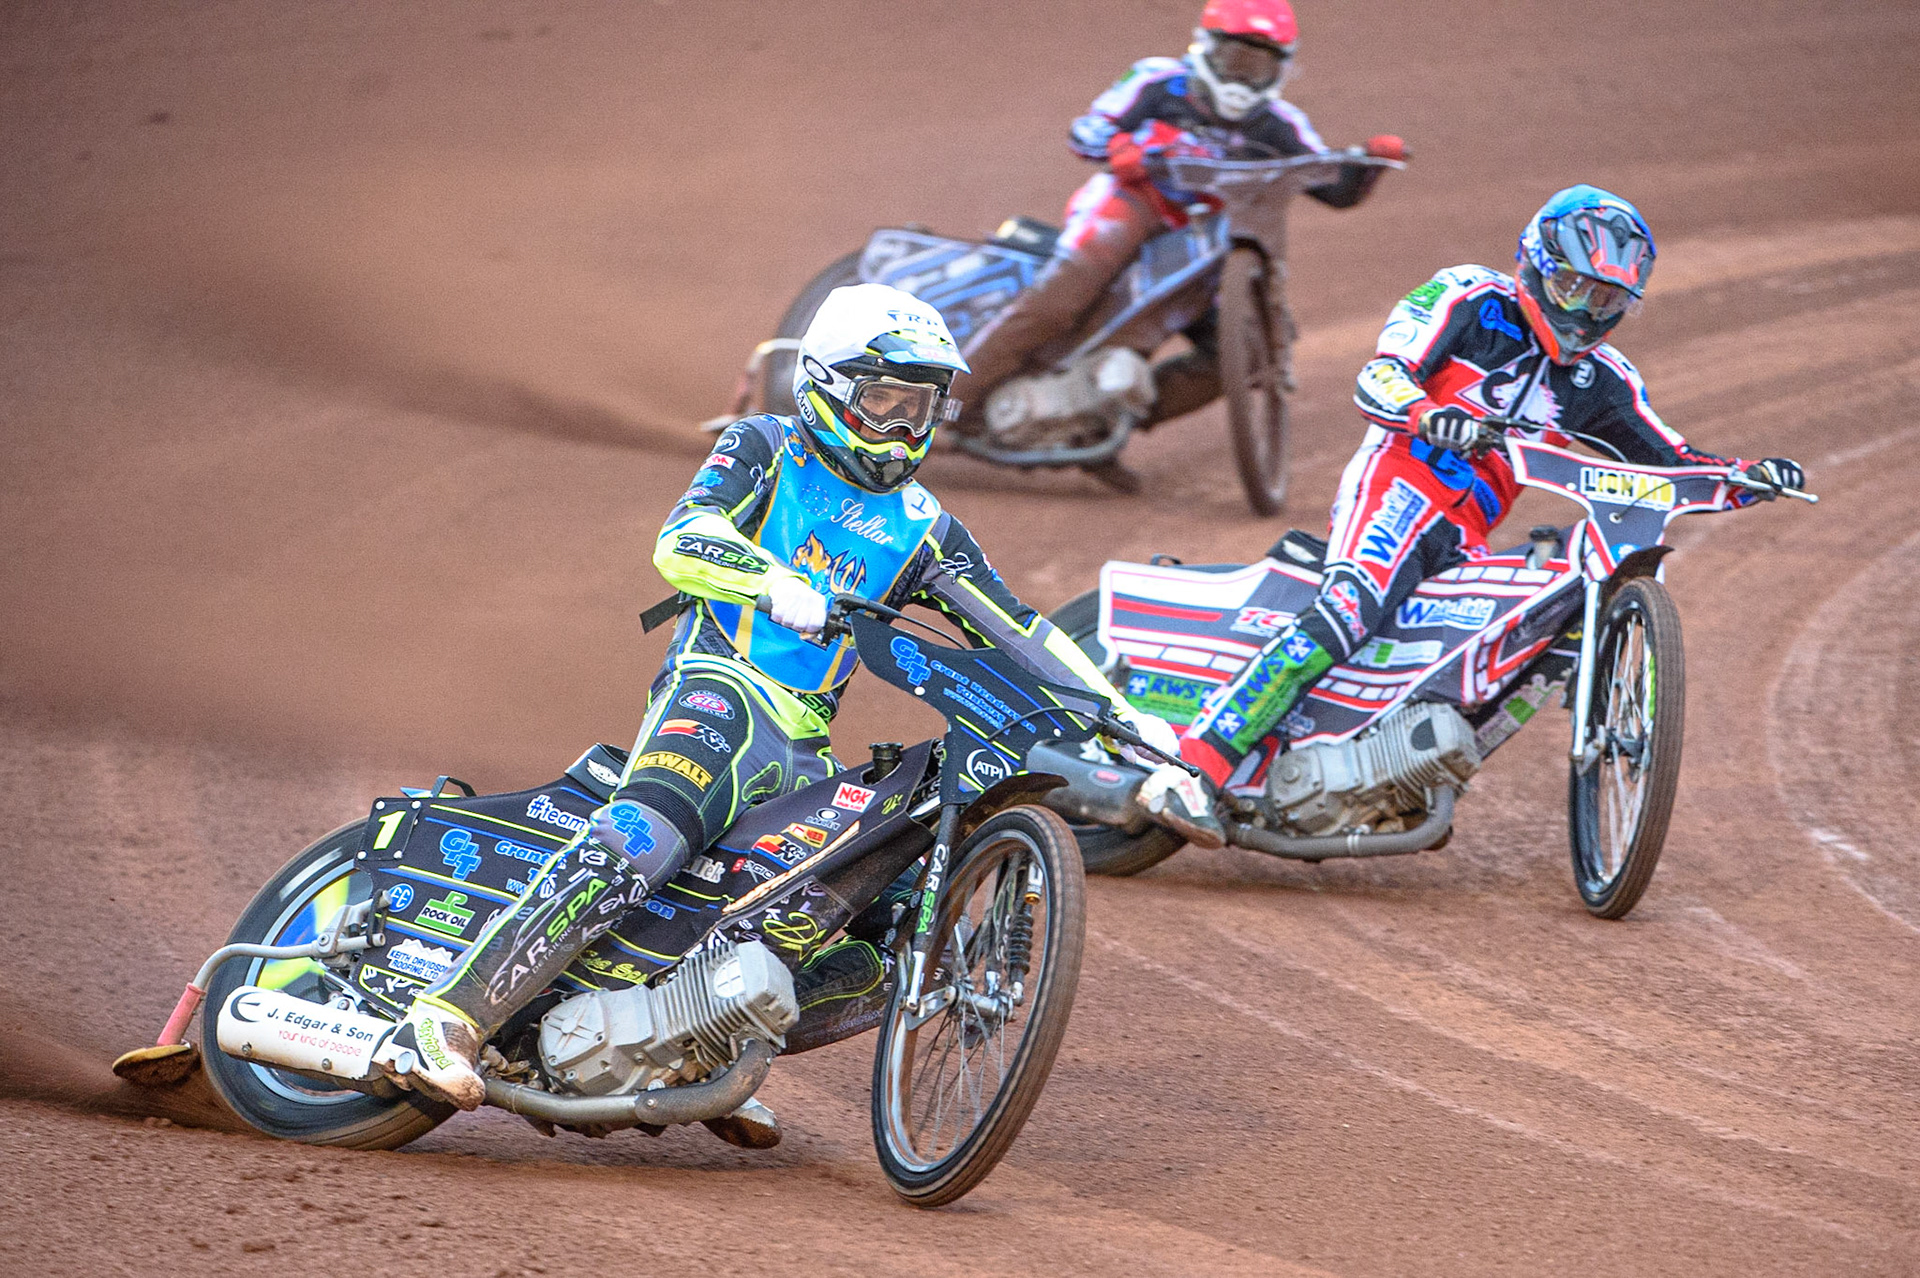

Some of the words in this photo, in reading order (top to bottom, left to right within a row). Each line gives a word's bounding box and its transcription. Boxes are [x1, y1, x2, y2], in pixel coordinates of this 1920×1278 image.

[830, 497, 894, 545] Stellar
[930, 660, 970, 685] Grant
[1235, 652, 1285, 712] RWS
[1150, 678, 1199, 699] RWS
[692, 695, 720, 709] STS
[956, 683, 1006, 722] Tankers
[974, 761, 1003, 779] ATPI
[838, 786, 872, 805] NGK
[373, 810, 406, 850] 1
[495, 840, 551, 866] Grant
[421, 907, 448, 923] ROCK
[450, 916, 467, 928] OIL
[390, 949, 411, 962] KEITH
[531, 925, 575, 974] DETAILING
[391, 960, 424, 976] ROOFING
[424, 970, 439, 980] LTD
[267, 1008, 279, 1020] J.
[284, 1012, 328, 1030] Edgar
[331, 1023, 342, 1034] &
[346, 1027, 374, 1042] Son
